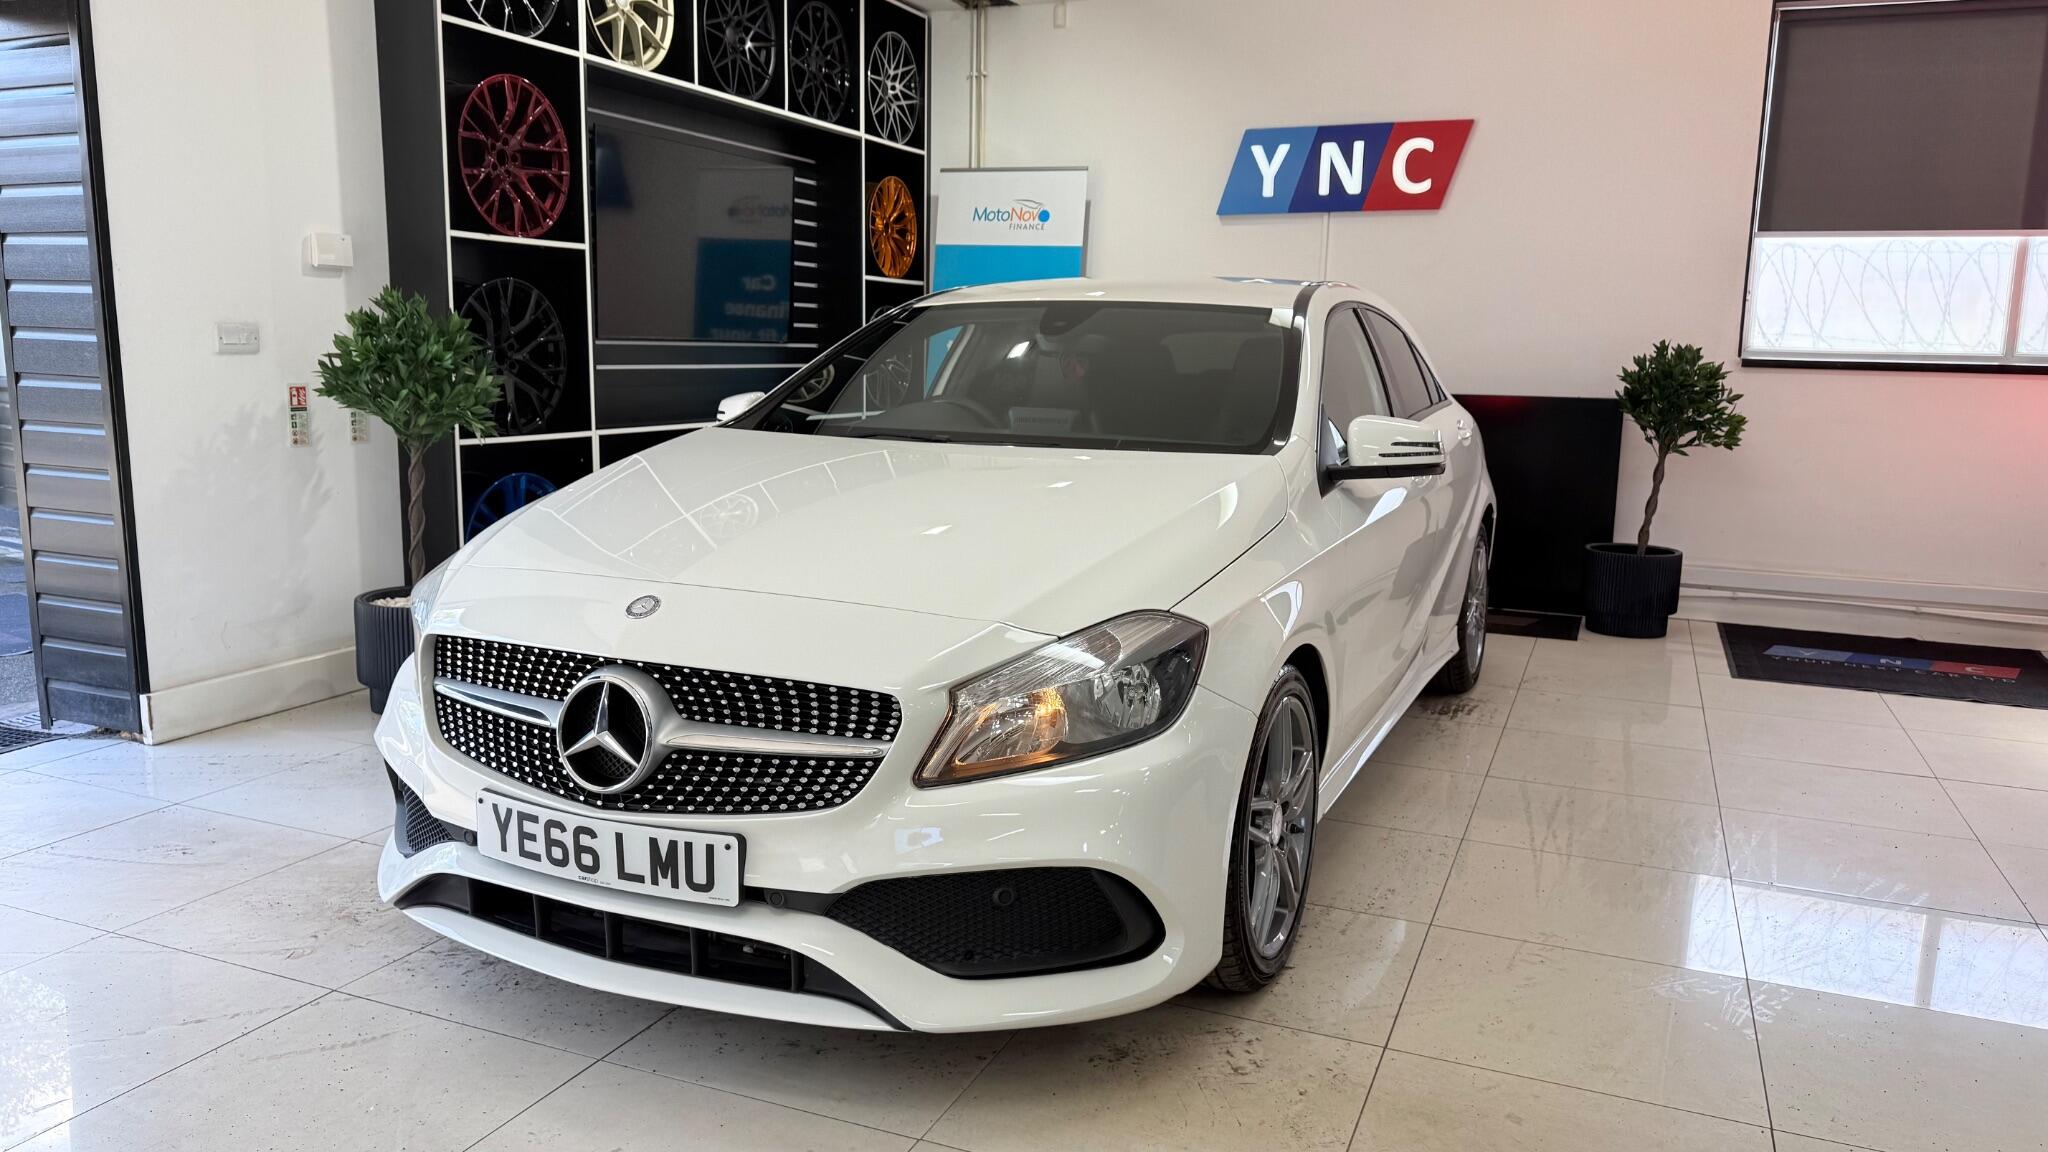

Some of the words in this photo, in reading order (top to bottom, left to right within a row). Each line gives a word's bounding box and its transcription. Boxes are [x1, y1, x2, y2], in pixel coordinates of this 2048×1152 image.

[1251, 137, 1434, 197] YNC
[1009, 223, 1045, 231] FINANCE
[1771, 656, 1831, 665] YOUR
[1844, 662, 1900, 672] NEXT
[1914, 669, 1960, 678] CAR
[492, 803, 600, 875] YE66
[615, 831, 715, 893] LMU
